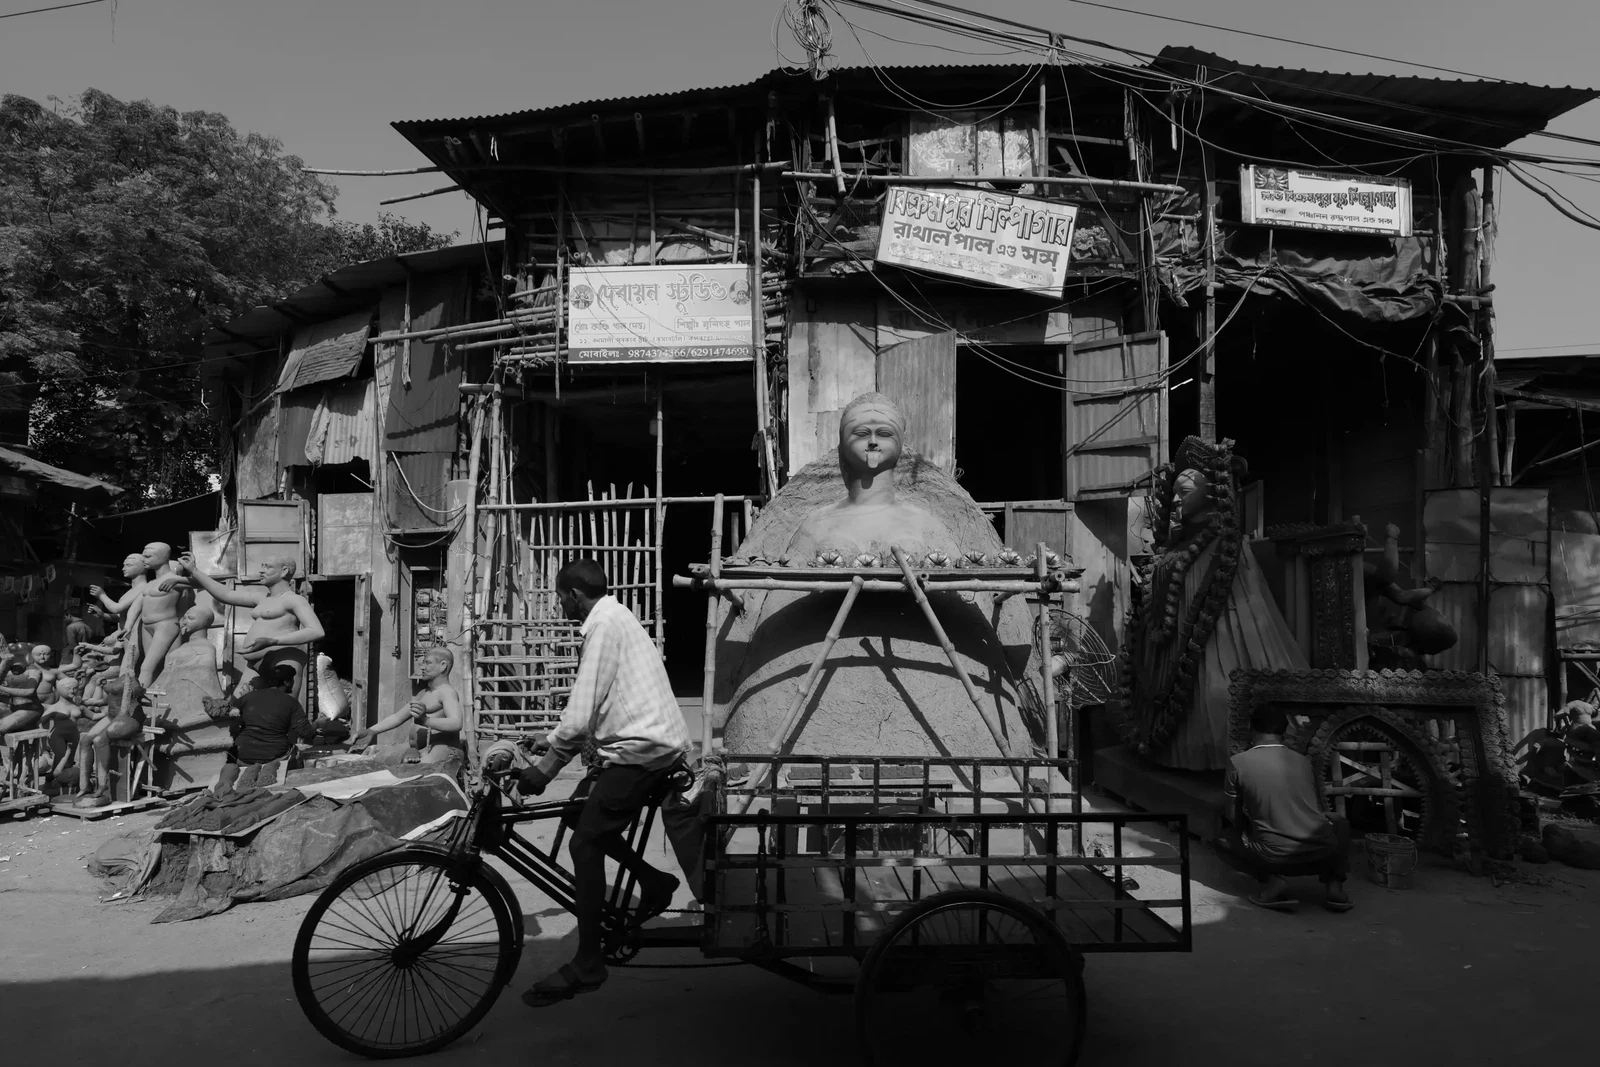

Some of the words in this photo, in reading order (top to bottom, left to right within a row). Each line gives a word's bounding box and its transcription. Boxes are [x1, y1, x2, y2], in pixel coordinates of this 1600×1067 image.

[1261, 190, 1284, 201] নিউ
[1285, 190, 1332, 208] বিক্রমপুর
[1333, 192, 1348, 210] মৃৎ
[976, 191, 1073, 246] শিল্পাগার
[892, 220, 952, 247] রাখাল
[953, 232, 995, 255] পাল
[597, 283, 660, 312] দেবায়ন
[702, 317, 731, 331] নৃসিংহ
[734, 319, 751, 328] পাল
